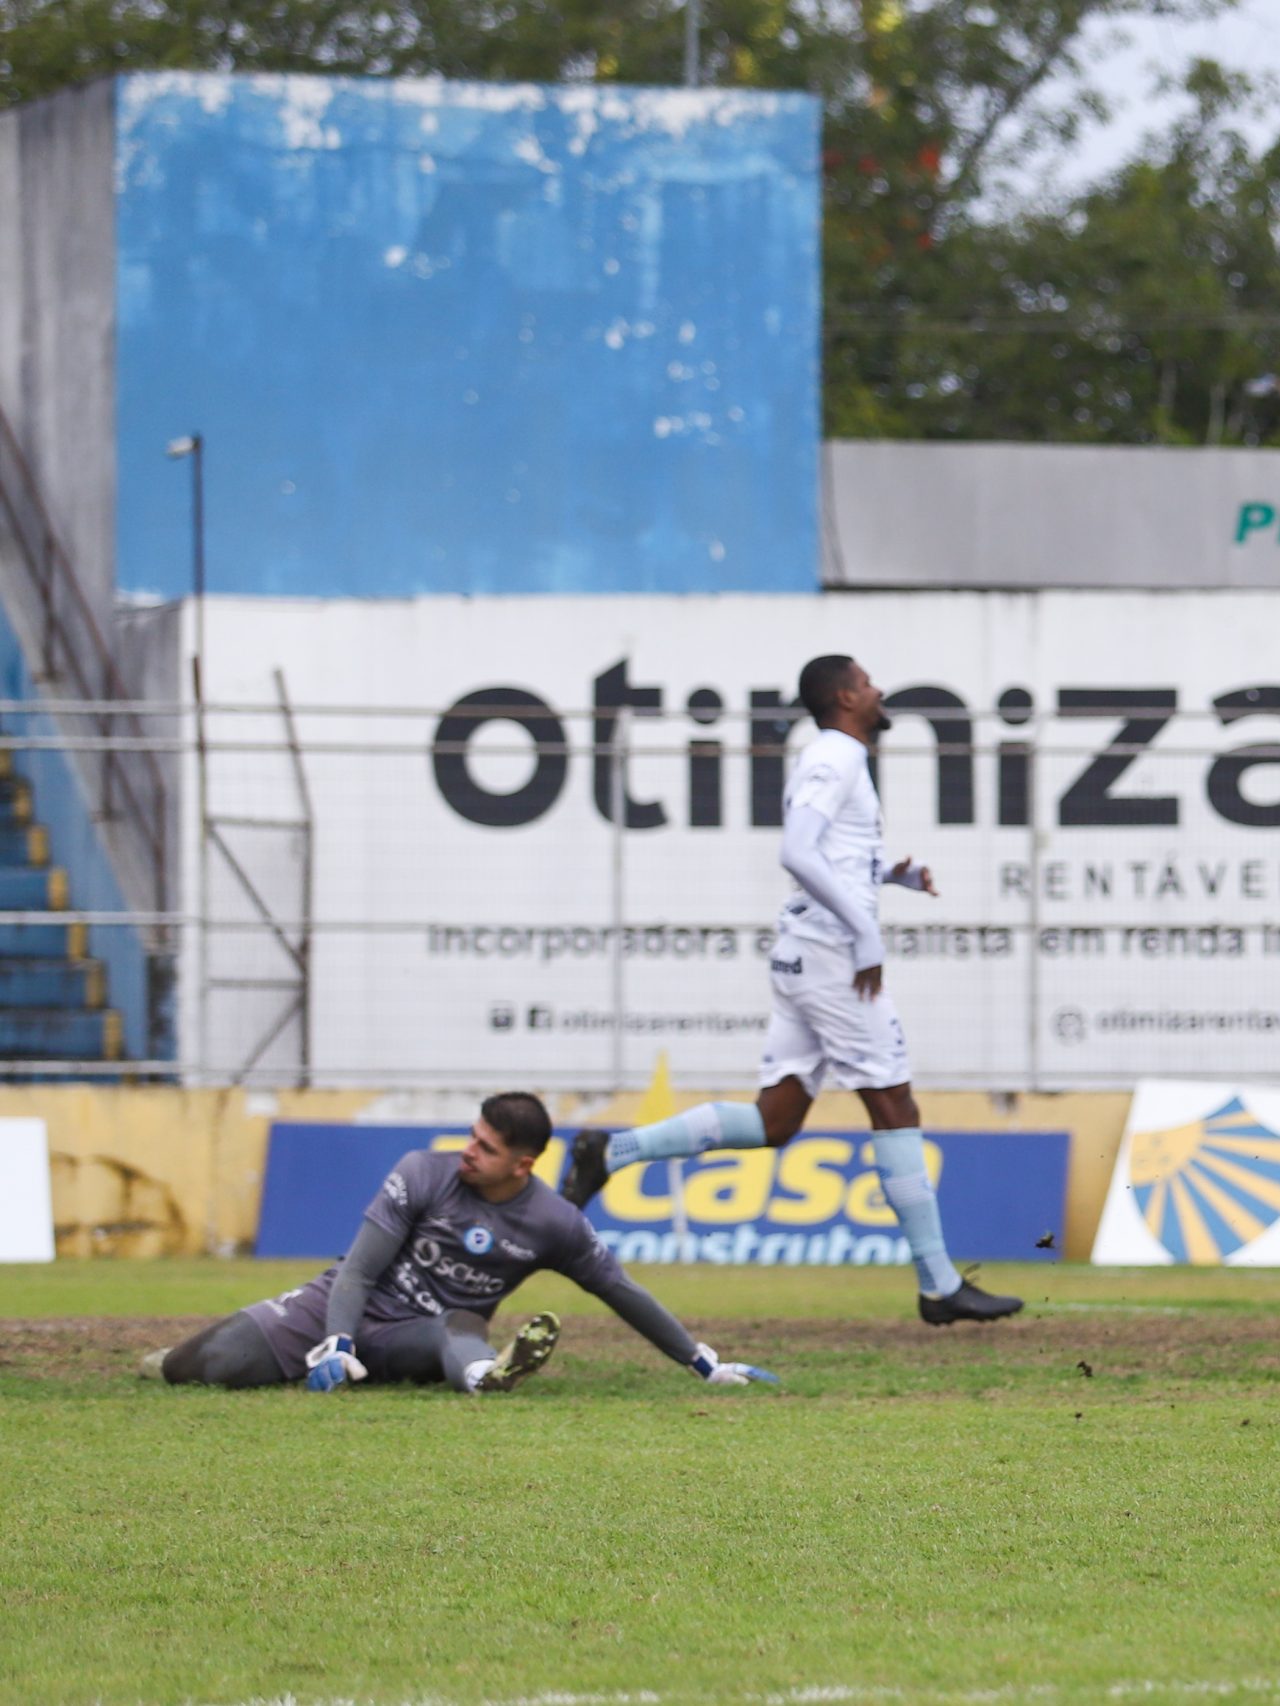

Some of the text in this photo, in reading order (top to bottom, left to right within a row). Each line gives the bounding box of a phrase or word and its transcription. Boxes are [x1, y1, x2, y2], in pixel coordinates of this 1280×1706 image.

[753, 918, 1014, 958] eialista
[1038, 926, 1104, 958] em
[1120, 919, 1246, 958] renda
